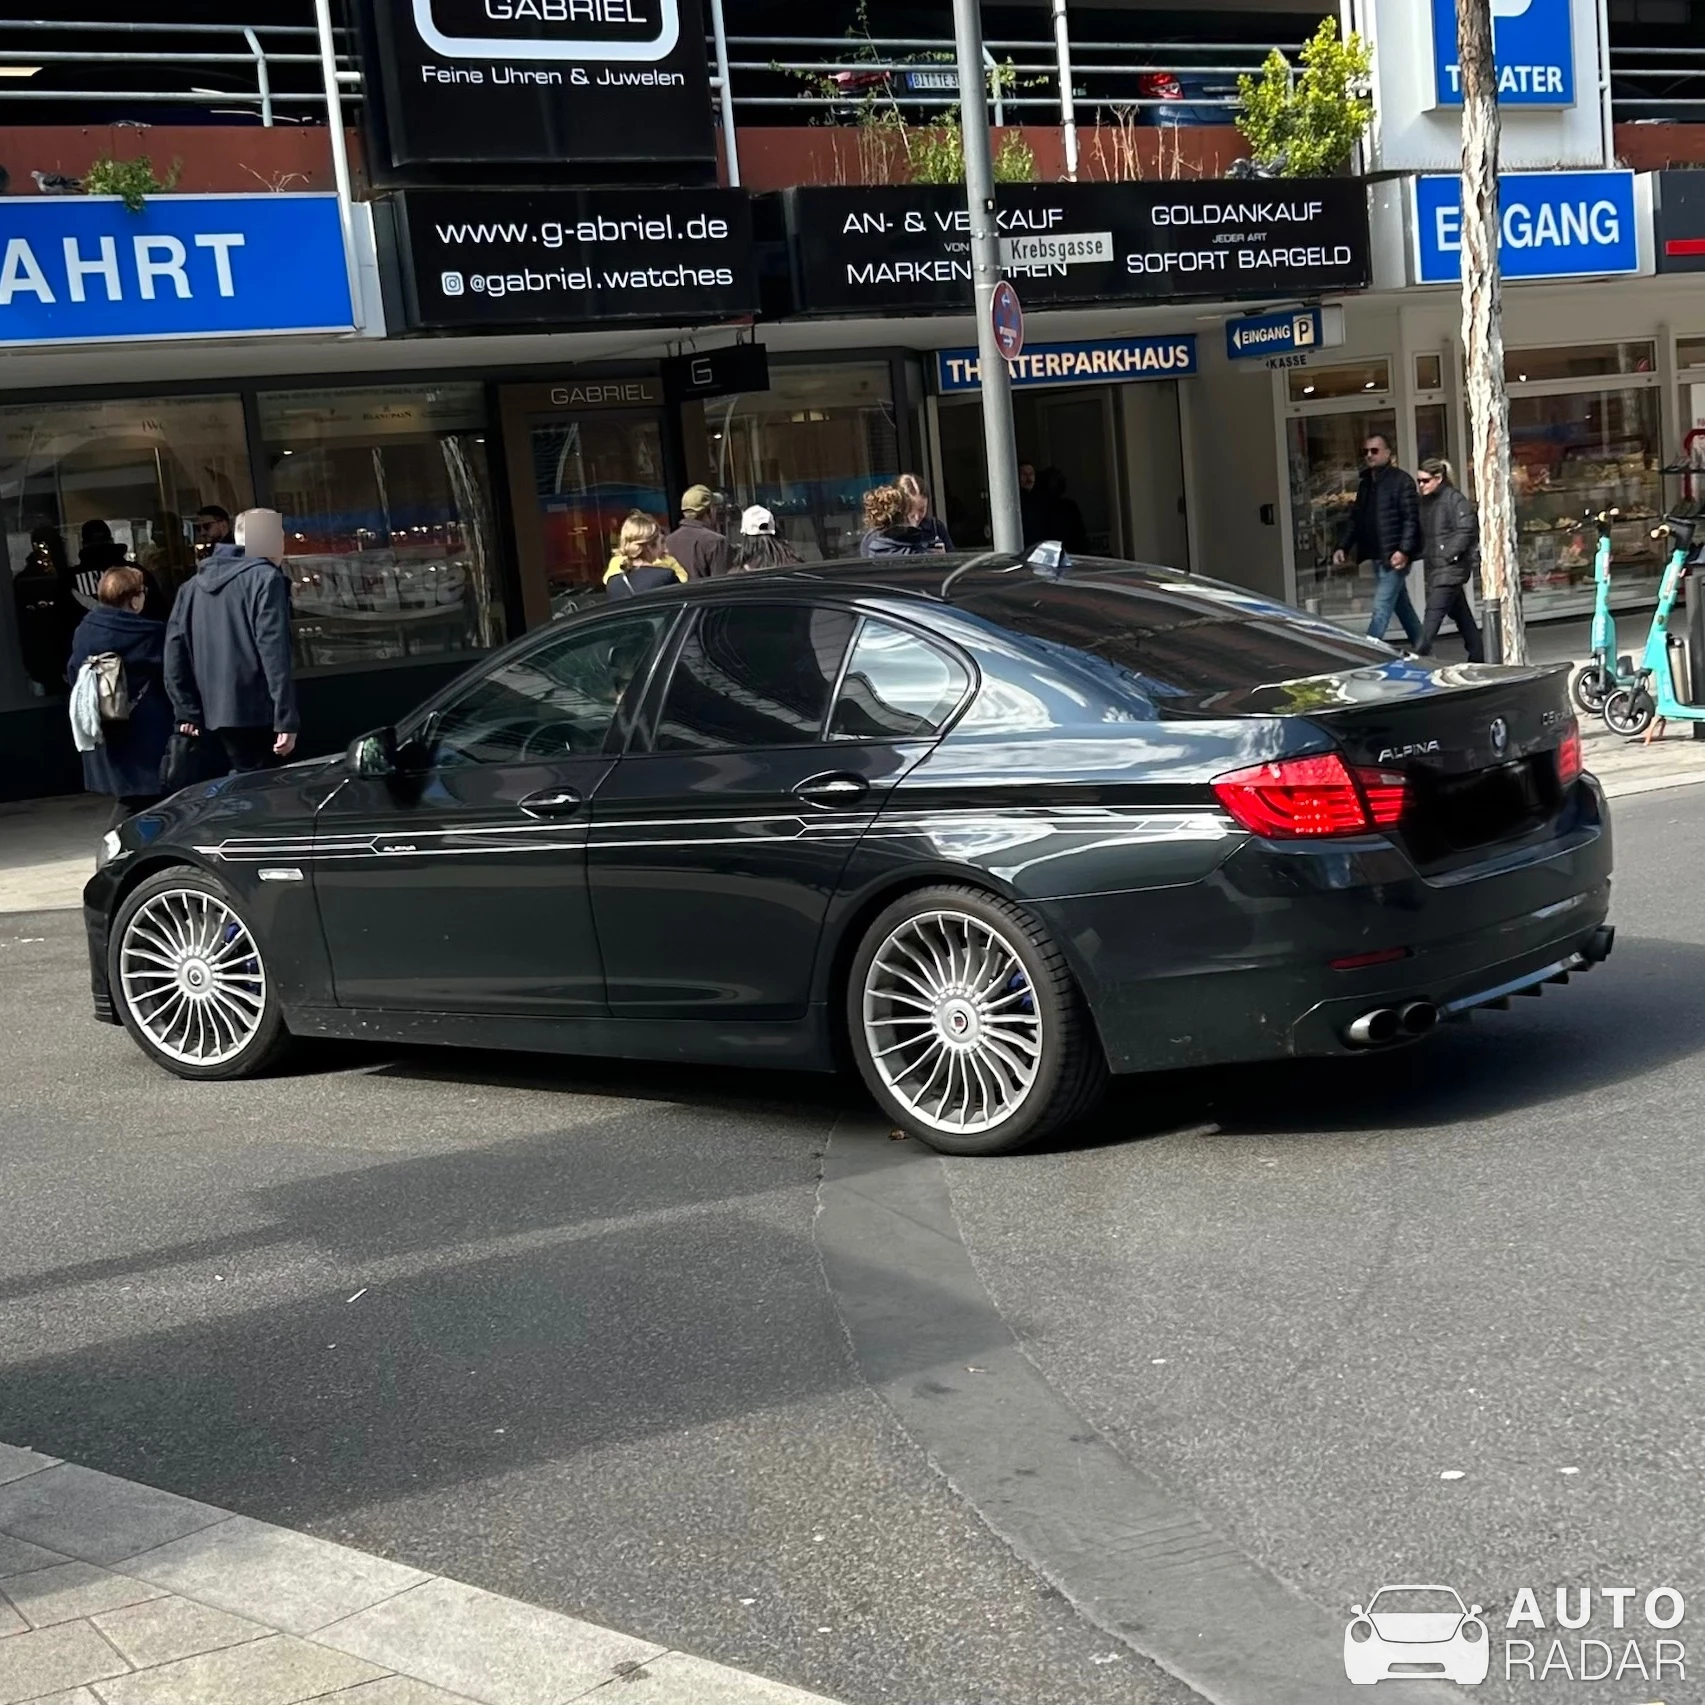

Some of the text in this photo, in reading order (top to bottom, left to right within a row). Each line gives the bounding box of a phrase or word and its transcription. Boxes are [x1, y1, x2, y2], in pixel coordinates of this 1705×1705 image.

[484, 0, 647, 23] GABRIEL
[421, 65, 685, 86] Feine Uhren & Juwelen
[1445, 65, 1564, 92] TATER
[842, 209, 1064, 233] AN- & VEKAUF
[1151, 202, 1323, 225] GOLDANKAUF
[435, 214, 729, 248] www.g-abriel.de
[1212, 232, 1268, 243] JEDER ART
[1435, 200, 1620, 252] EGANG
[944, 243, 970, 253] VON
[1011, 238, 1104, 262] Krebsgasse
[0, 233, 246, 304] AHRT
[1127, 246, 1352, 274] SOFORT BARGELD
[470, 264, 733, 297] @gabriel.watches
[847, 261, 1068, 284] MARKENREN
[1242, 325, 1291, 345] EINGANG
[691, 358, 713, 385] G
[946, 345, 1190, 383] THTERPARKHAUS
[1270, 355, 1307, 369] KASSE
[551, 384, 653, 405] GABRIEL
[1378, 740, 1440, 762] ALPINA
